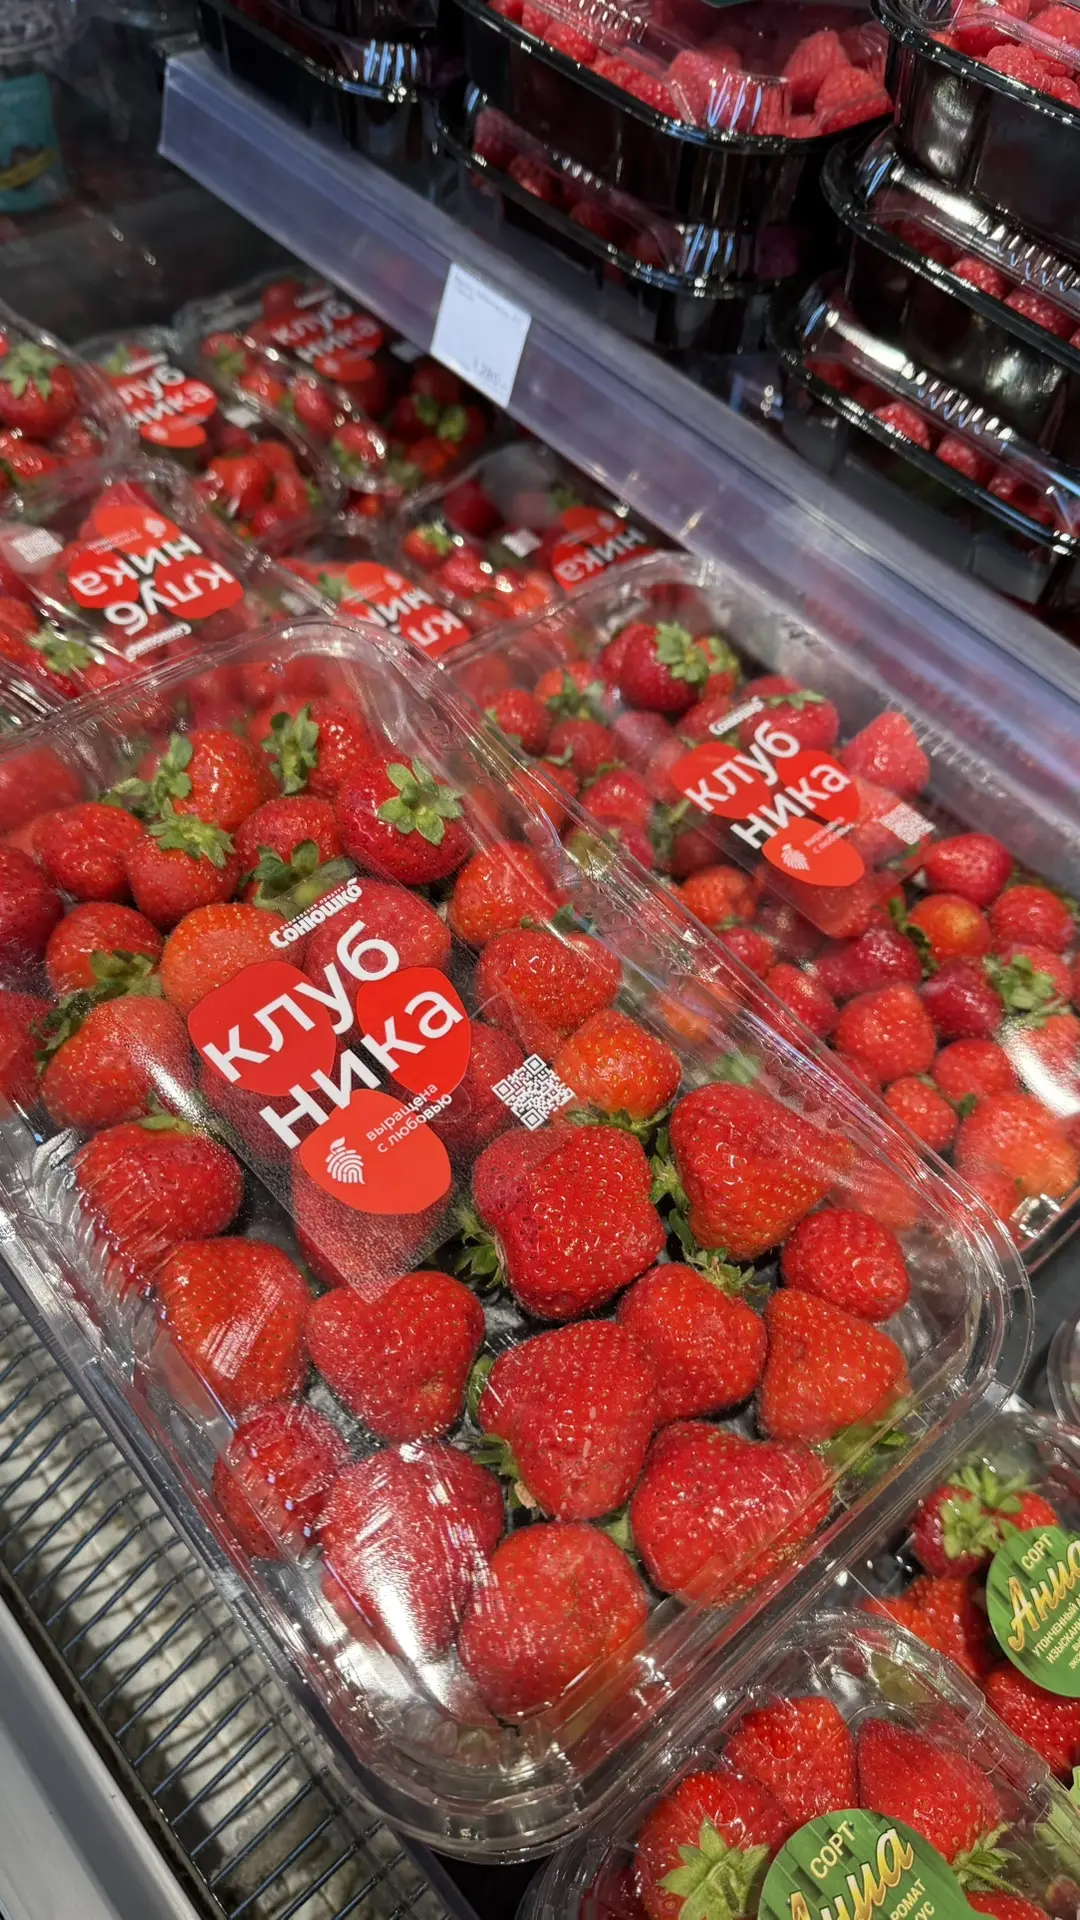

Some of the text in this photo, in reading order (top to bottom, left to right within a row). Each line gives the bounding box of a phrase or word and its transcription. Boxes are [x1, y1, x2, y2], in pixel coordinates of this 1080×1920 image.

[117, 364, 185, 405] луб
[69, 533, 203, 596] ника
[104, 562, 235, 636] клуб
[357, 587, 434, 628] ник
[684, 720, 800, 812] клуб
[730, 764, 851, 849] ника
[203, 920, 400, 1083] клуб
[258, 991, 464, 1150] ника
[366, 1083, 439, 1142] выращена
[377, 1093, 453, 1153] с любовью
[1020, 1533, 1054, 1573] СОРТ
[1032, 1602, 1080, 1657] УТОНЧЕННЫЙ
[810, 1820, 857, 1879] СОРТ
